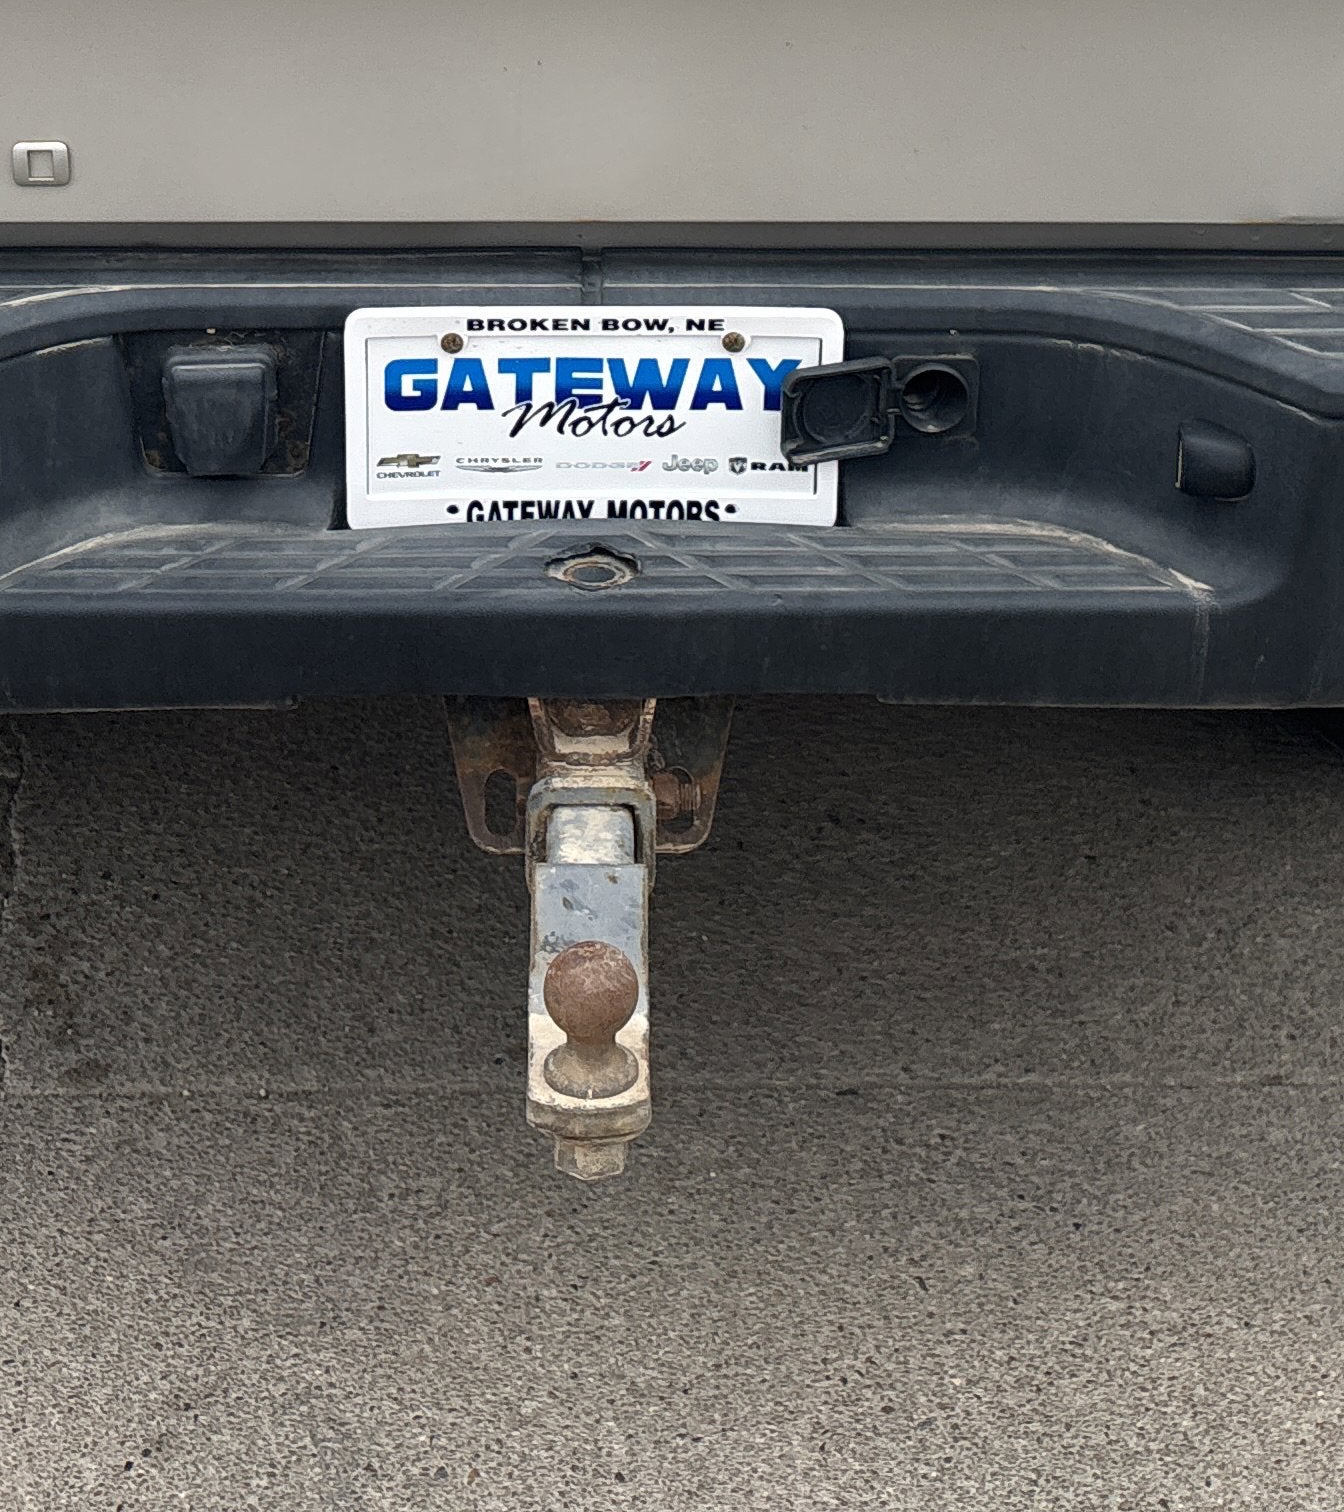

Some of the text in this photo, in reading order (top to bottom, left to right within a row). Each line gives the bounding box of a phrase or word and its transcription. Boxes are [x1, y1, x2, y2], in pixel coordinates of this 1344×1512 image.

[466, 318, 726, 334] BROKEN BOW, NE
[384, 357, 803, 412] GATEWAY
[502, 395, 687, 438] Motors
[376, 469, 441, 479] CHEVROLET
[455, 456, 544, 464] CHRYSLER
[662, 454, 719, 475] Jeep
[466, 499, 721, 523] GATEWAY MOTORS
